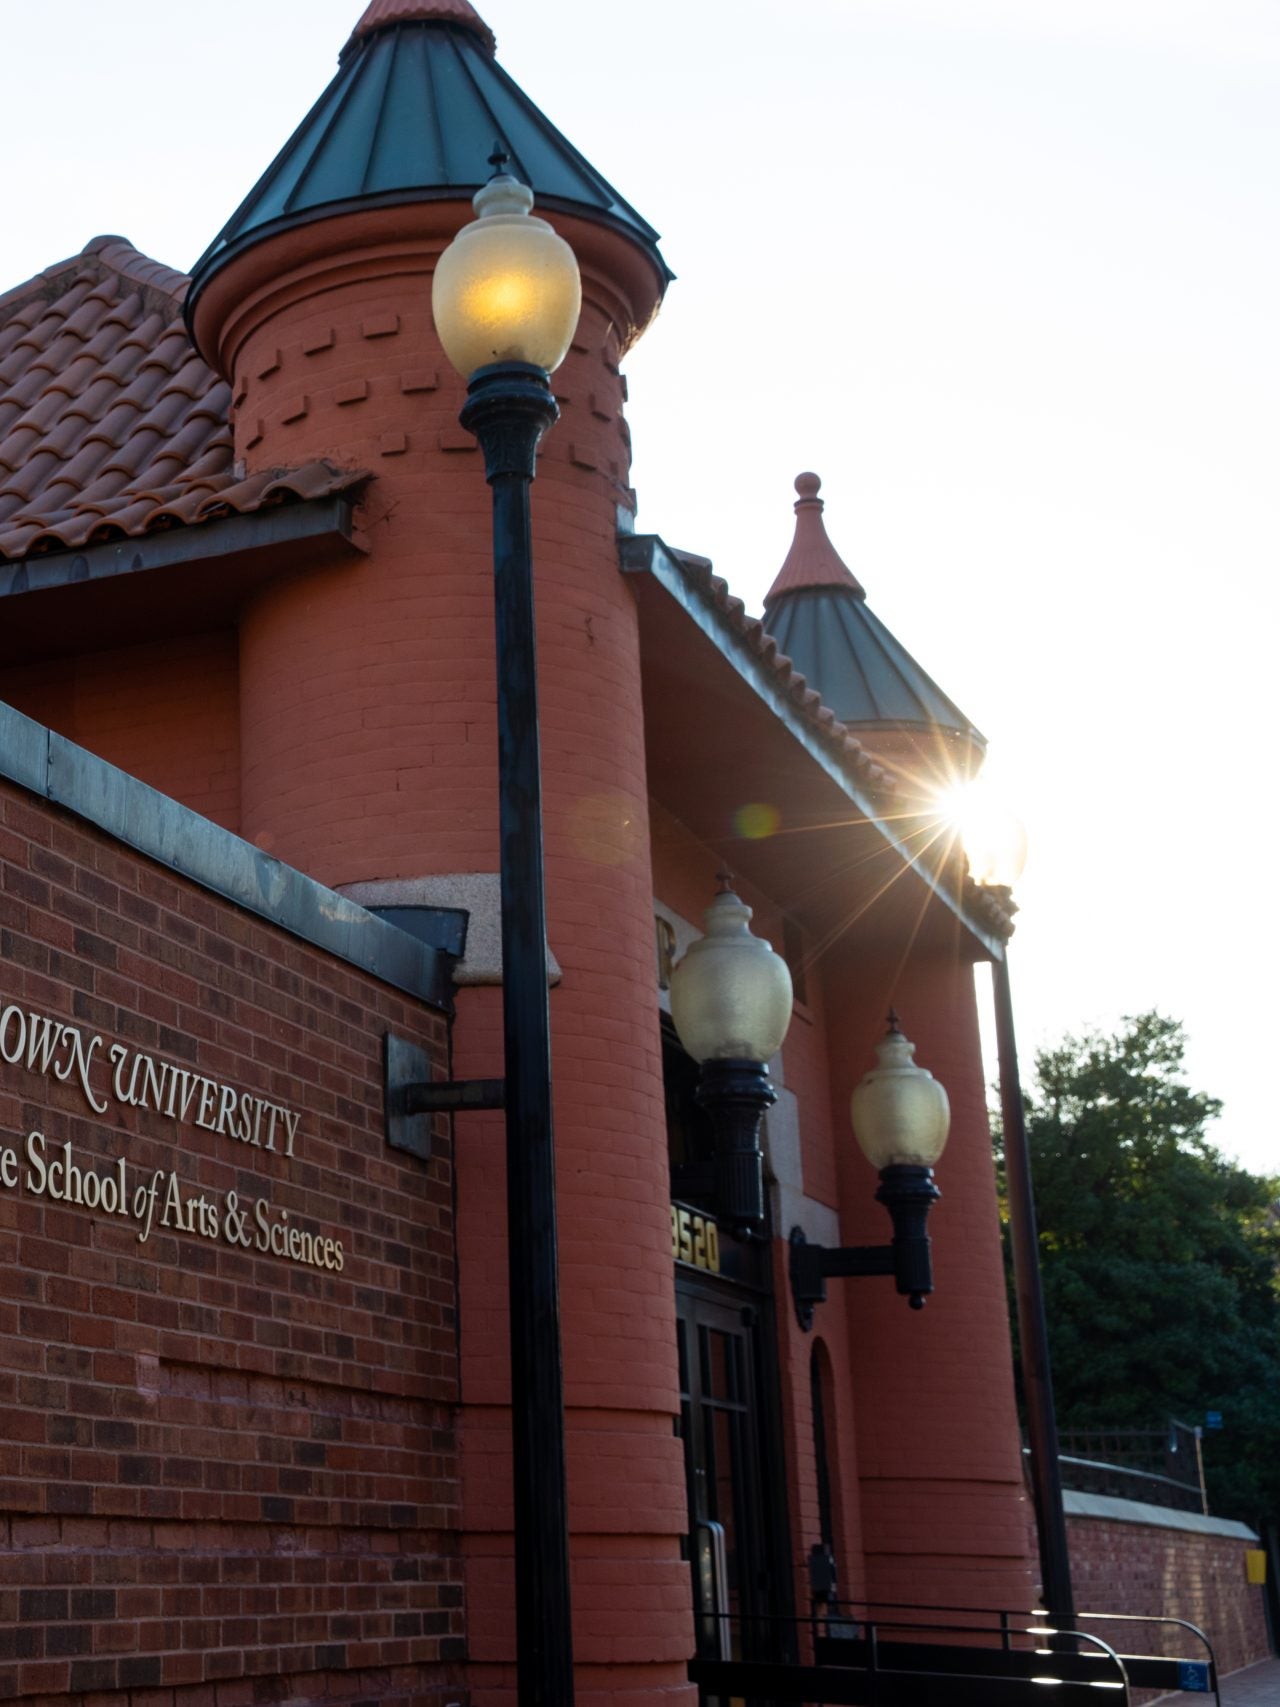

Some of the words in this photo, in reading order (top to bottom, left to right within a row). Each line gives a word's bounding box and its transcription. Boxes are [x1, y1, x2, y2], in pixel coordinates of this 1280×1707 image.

[110, 1043, 301, 1158] UNIVERSITY
[25, 1131, 128, 1216] School
[134, 1169, 162, 1243] of
[161, 1173, 218, 1239] Arts
[225, 1196, 253, 1248] &
[254, 1198, 344, 1272] Sciences
